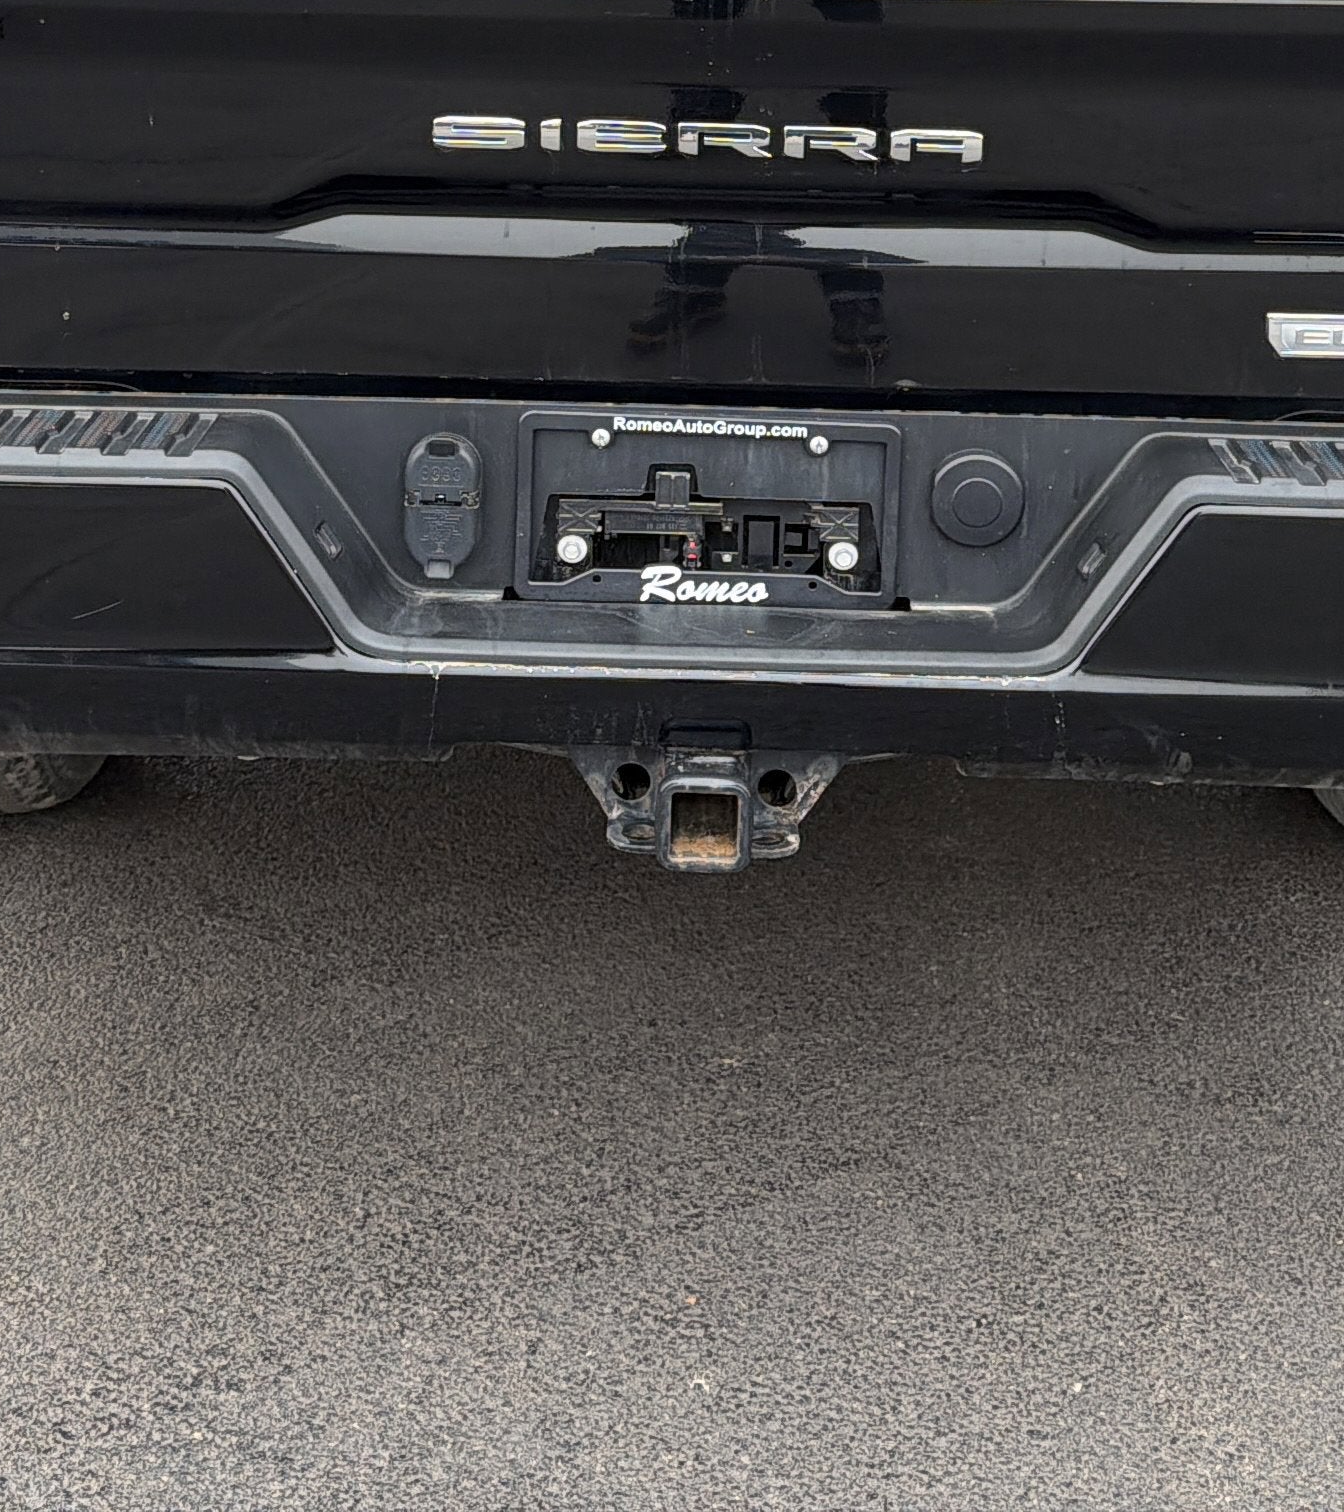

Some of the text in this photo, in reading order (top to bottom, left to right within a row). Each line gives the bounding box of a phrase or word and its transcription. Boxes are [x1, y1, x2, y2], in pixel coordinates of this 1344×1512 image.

[432, 115, 984, 163] SIERRA
[613, 417, 808, 439] RomeoAutoGroup.com
[640, 565, 769, 603] Romeo
